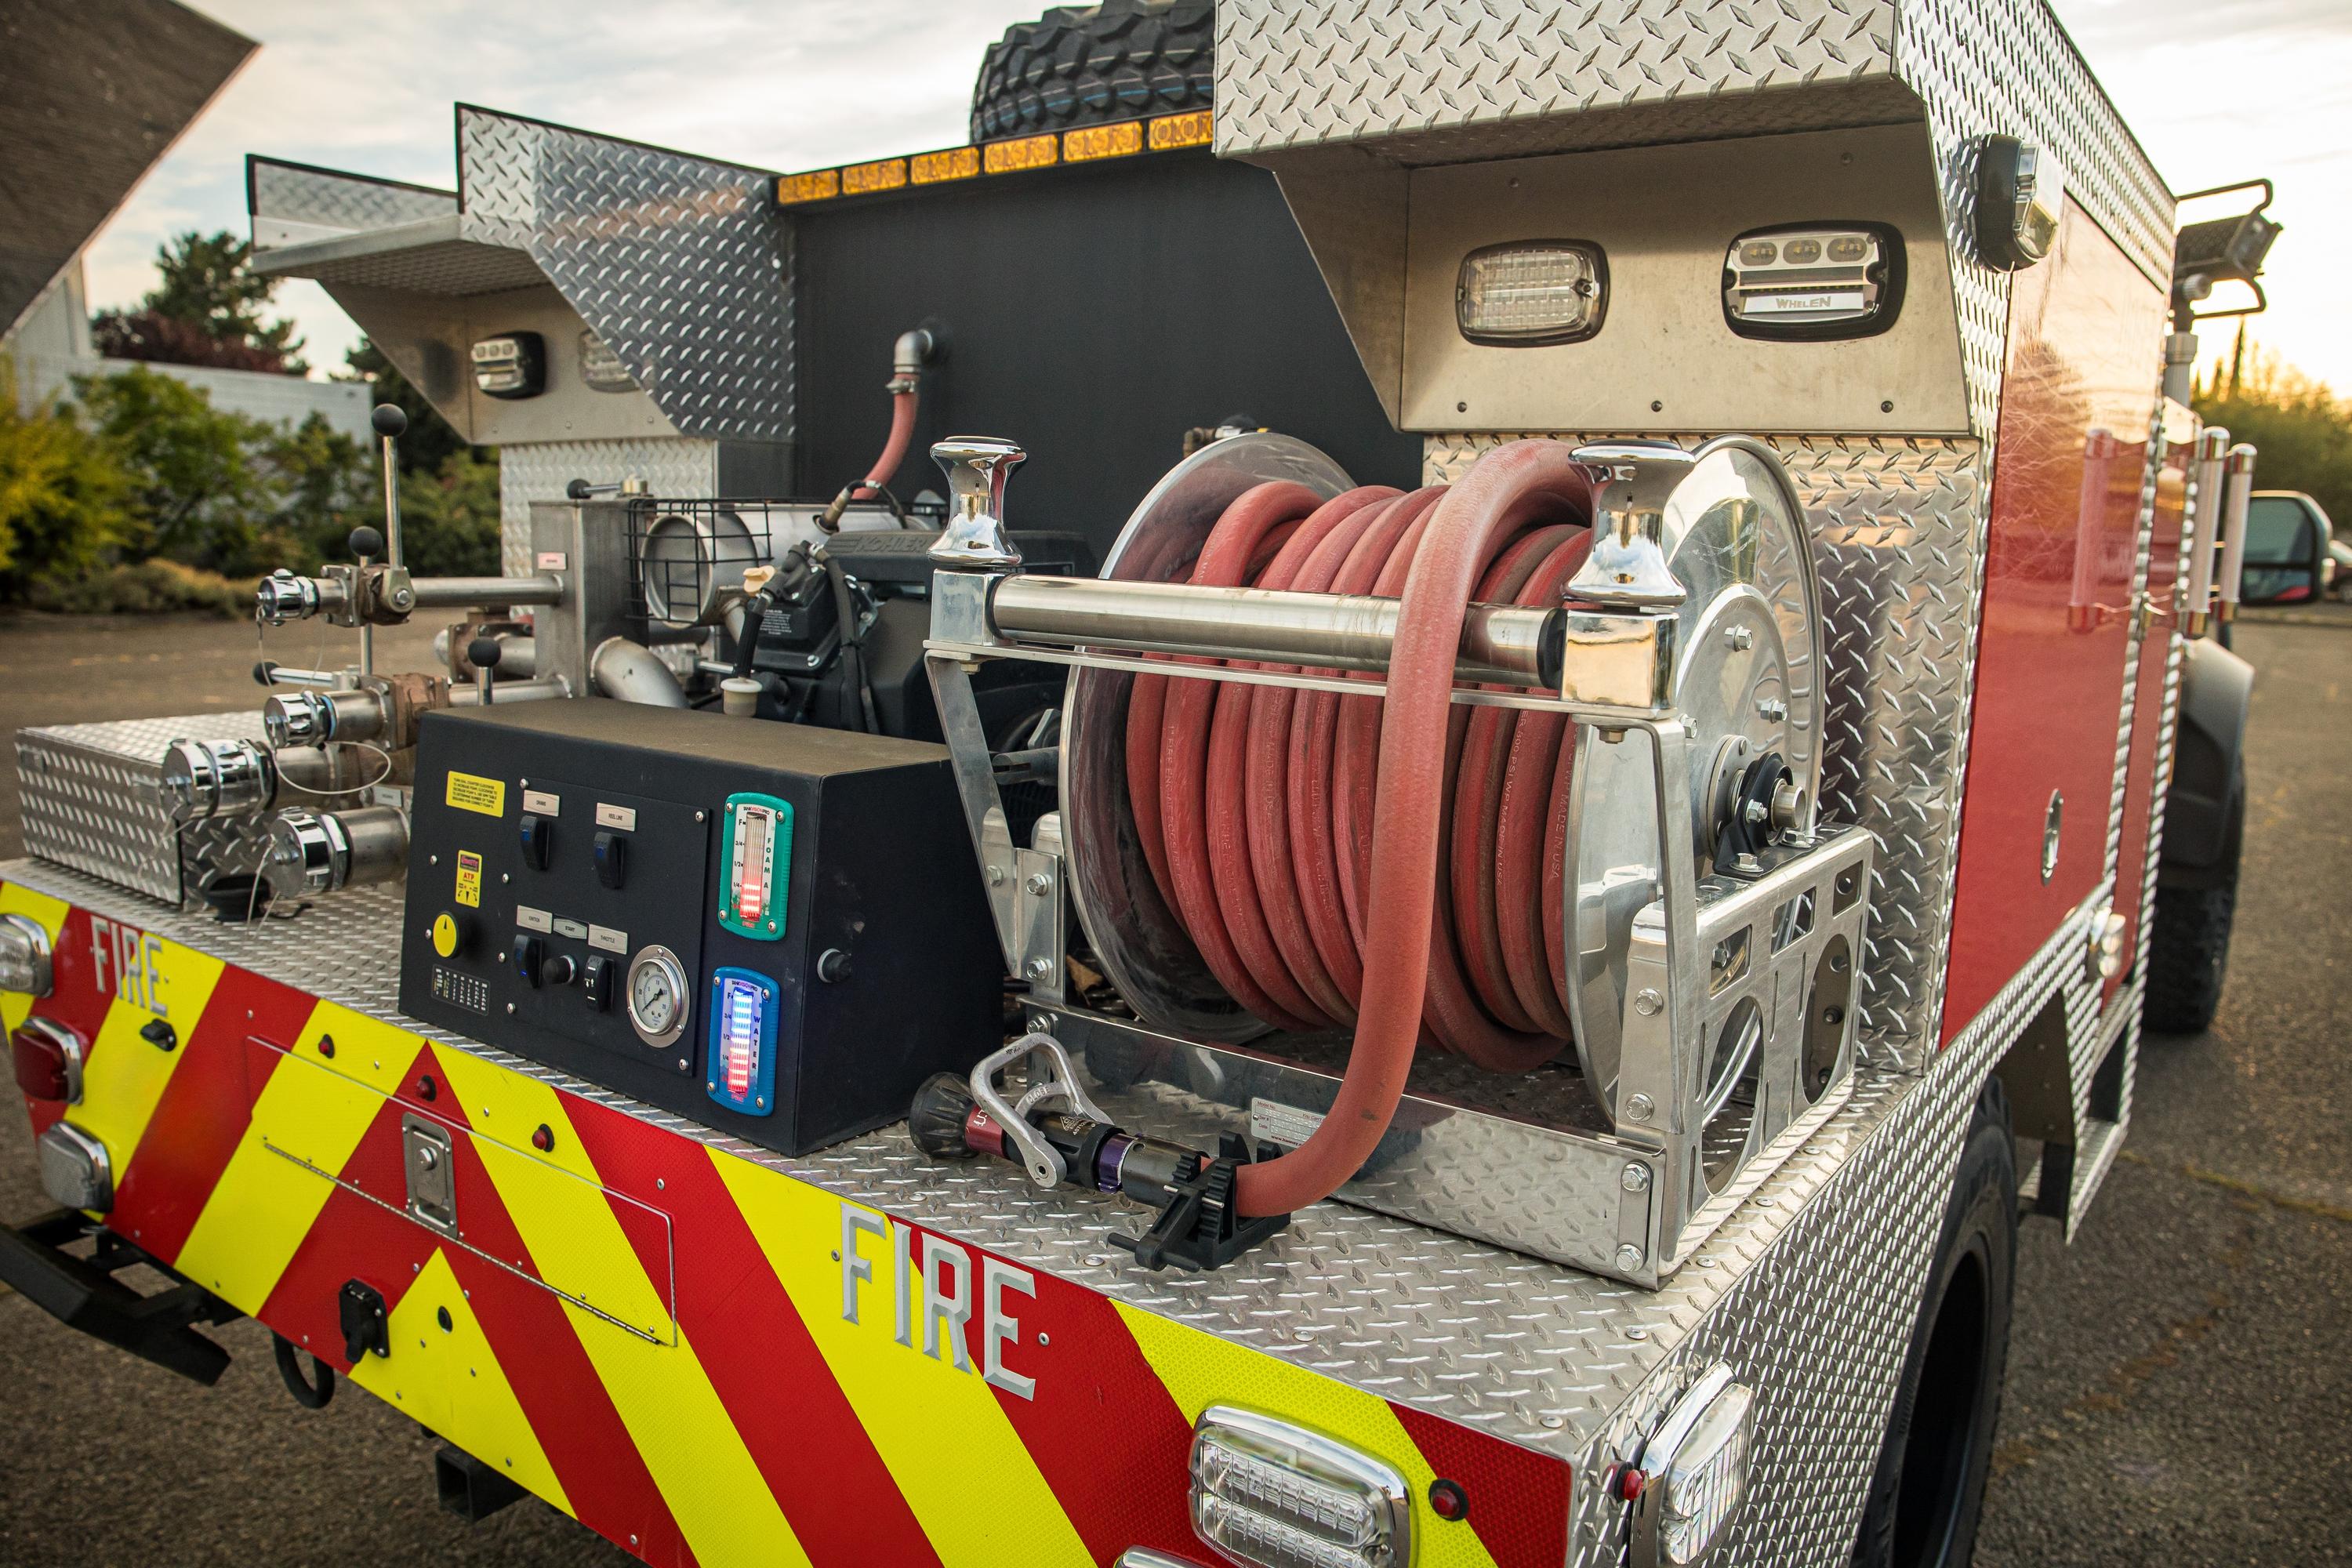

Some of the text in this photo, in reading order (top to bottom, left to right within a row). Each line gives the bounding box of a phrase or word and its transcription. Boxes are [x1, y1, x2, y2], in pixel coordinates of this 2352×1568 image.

[1776, 296, 1831, 309] WHELEN
[1508, 755, 1519, 778] PSI
[1504, 781, 1513, 802] WP
[601, 935, 615, 944] THROTTLE
[90, 914, 168, 1018] FIRE
[752, 1015, 760, 1069] WATER
[1028, 1086, 1051, 1105] CLOSE
[840, 1201, 1036, 1402] FIRE
